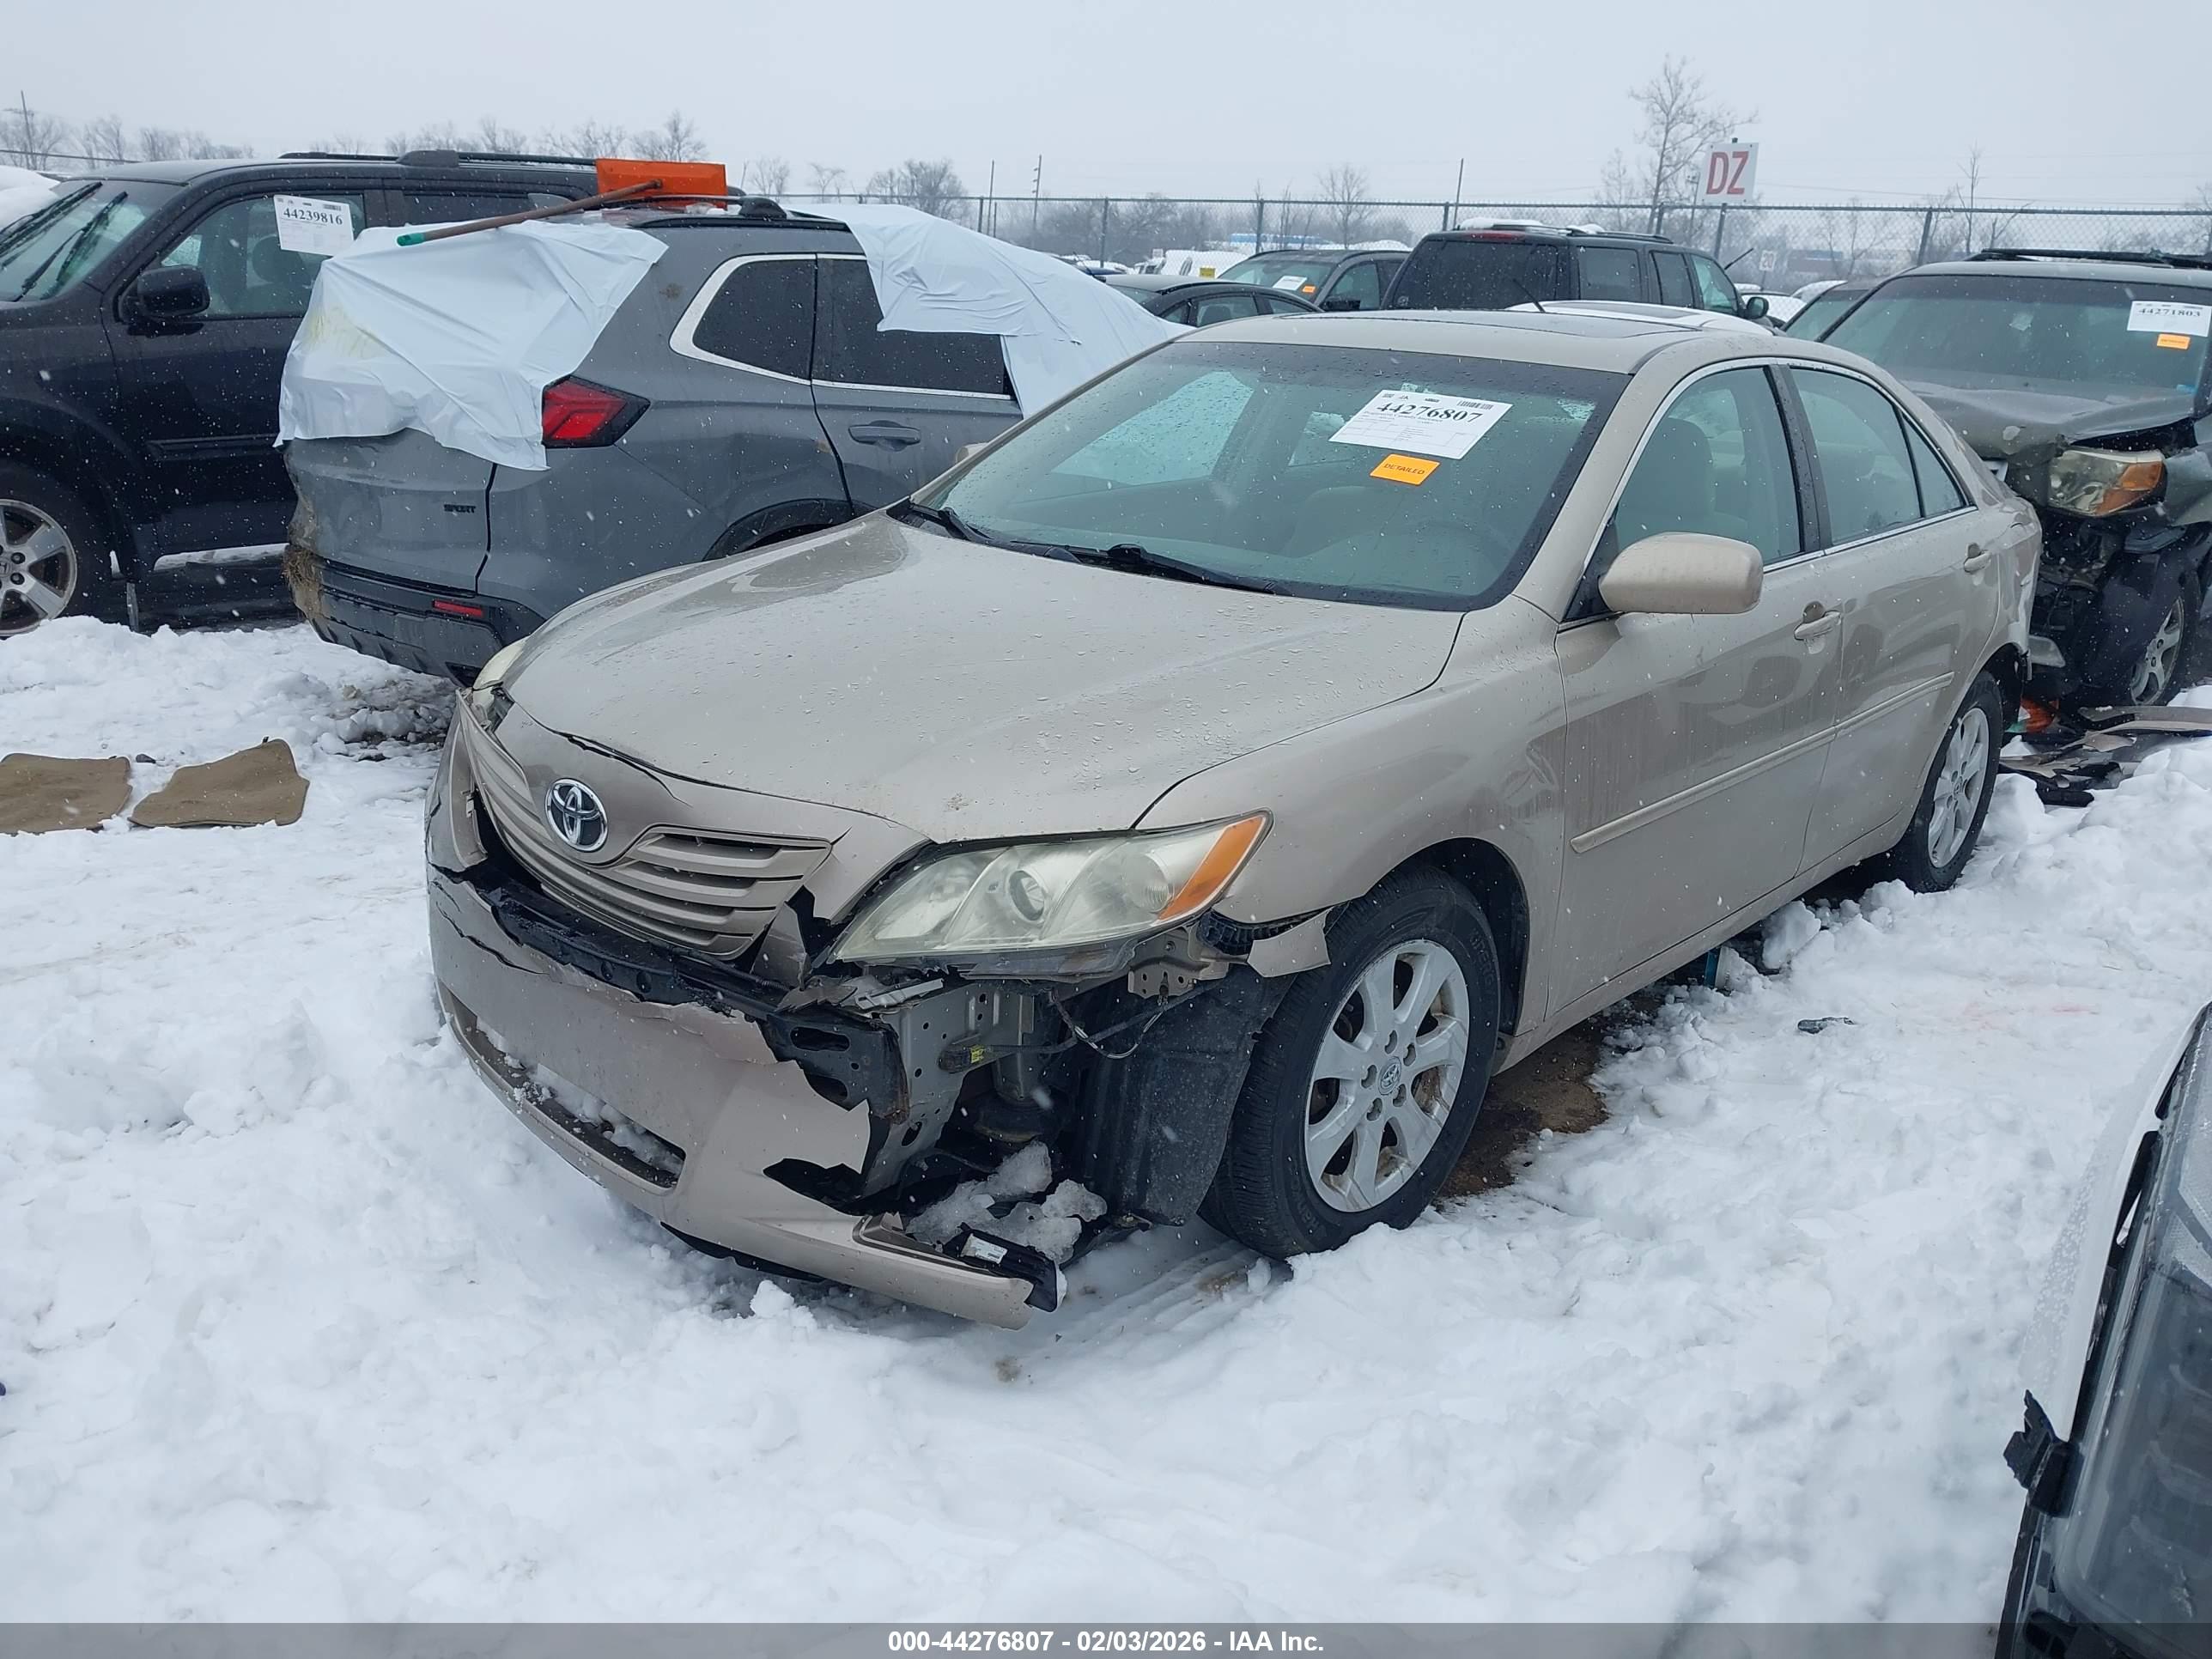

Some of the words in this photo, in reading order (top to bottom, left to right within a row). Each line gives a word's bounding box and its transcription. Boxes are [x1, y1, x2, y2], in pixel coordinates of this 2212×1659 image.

[1705, 150, 1749, 195] DZ
[283, 207, 343, 226] 44239816
[2138, 307, 2201, 317] 44271803
[1376, 401, 1483, 423] 44276807
[1383, 463, 1425, 475] DETAILED
[444, 504, 477, 514] SPORT
